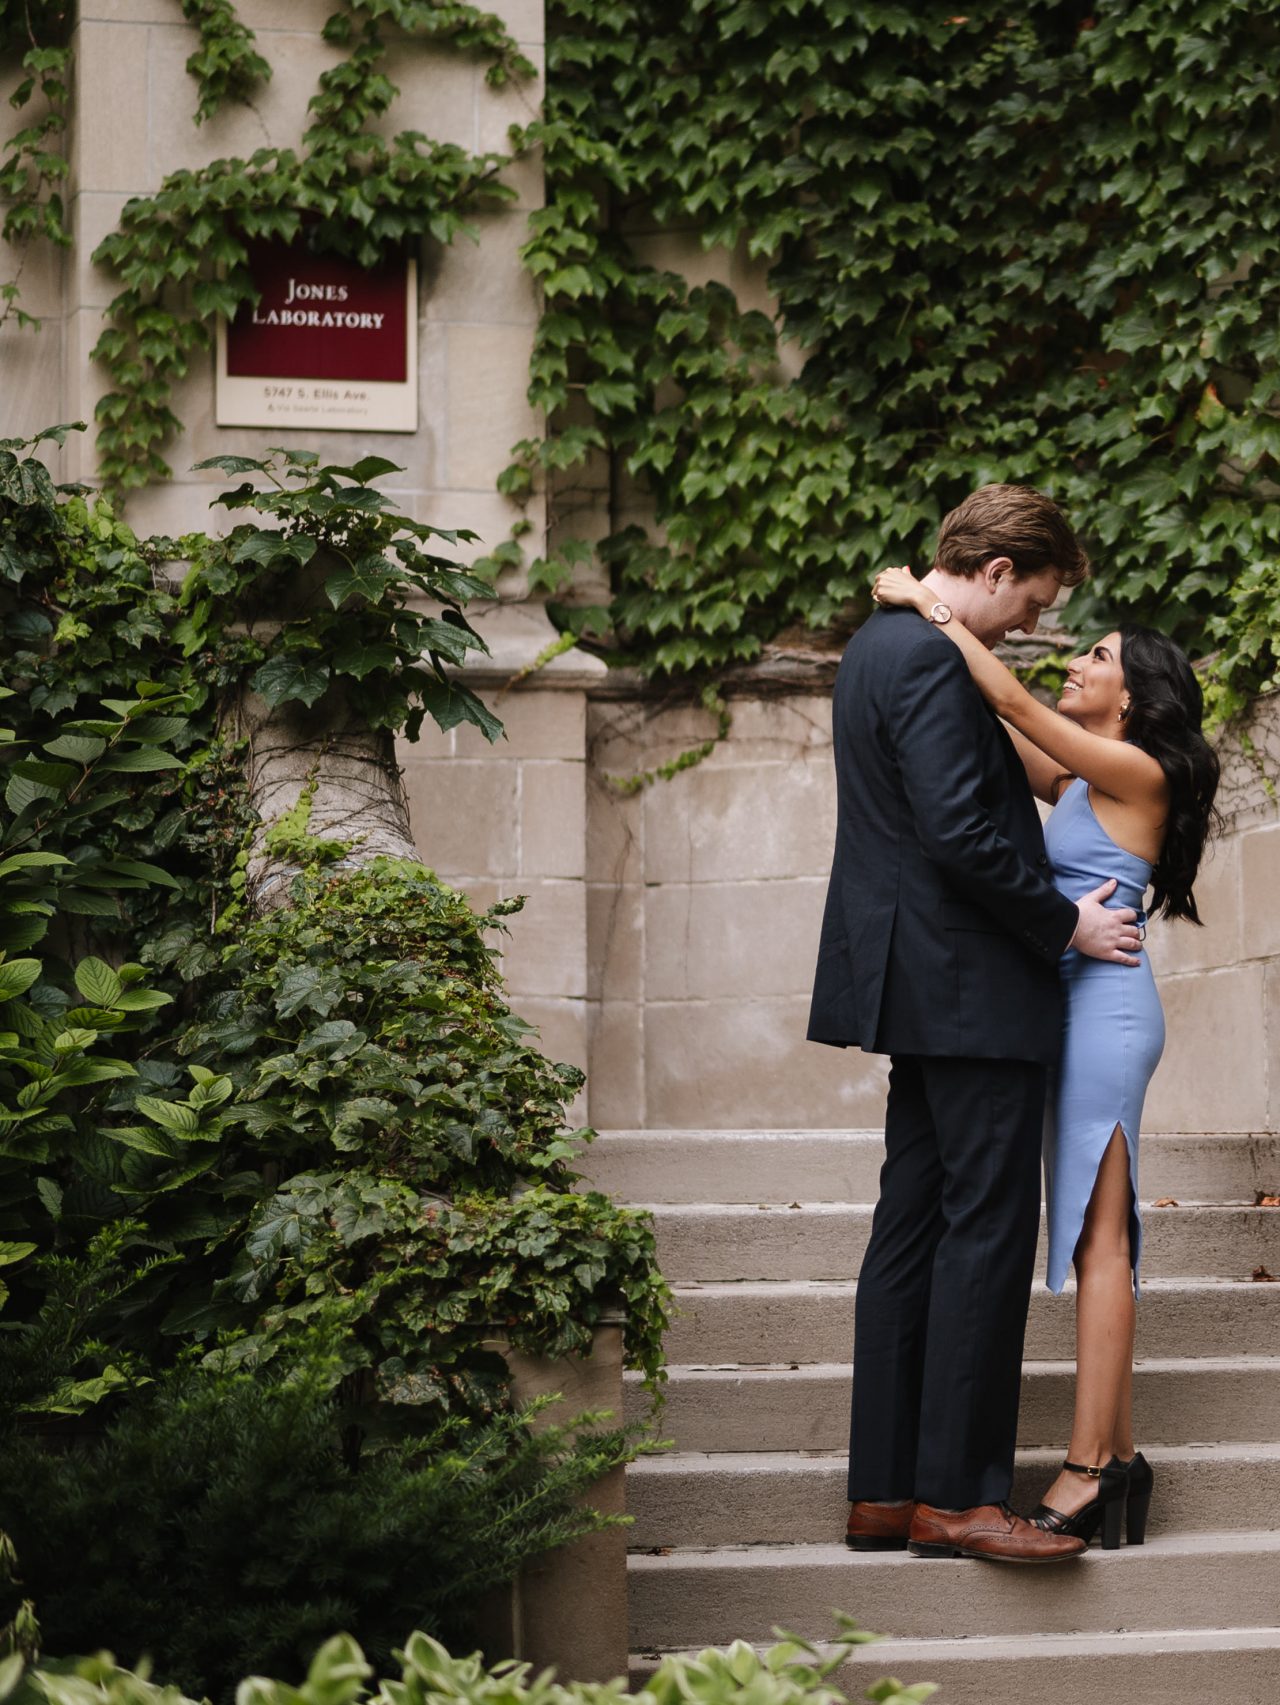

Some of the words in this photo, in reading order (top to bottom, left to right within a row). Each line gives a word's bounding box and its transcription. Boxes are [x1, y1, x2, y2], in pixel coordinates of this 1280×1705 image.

[284, 278, 349, 305] JONES
[252, 309, 385, 330] LABORATORY
[264, 386, 293, 398] 5747
[313, 388, 339, 400] Ellis
